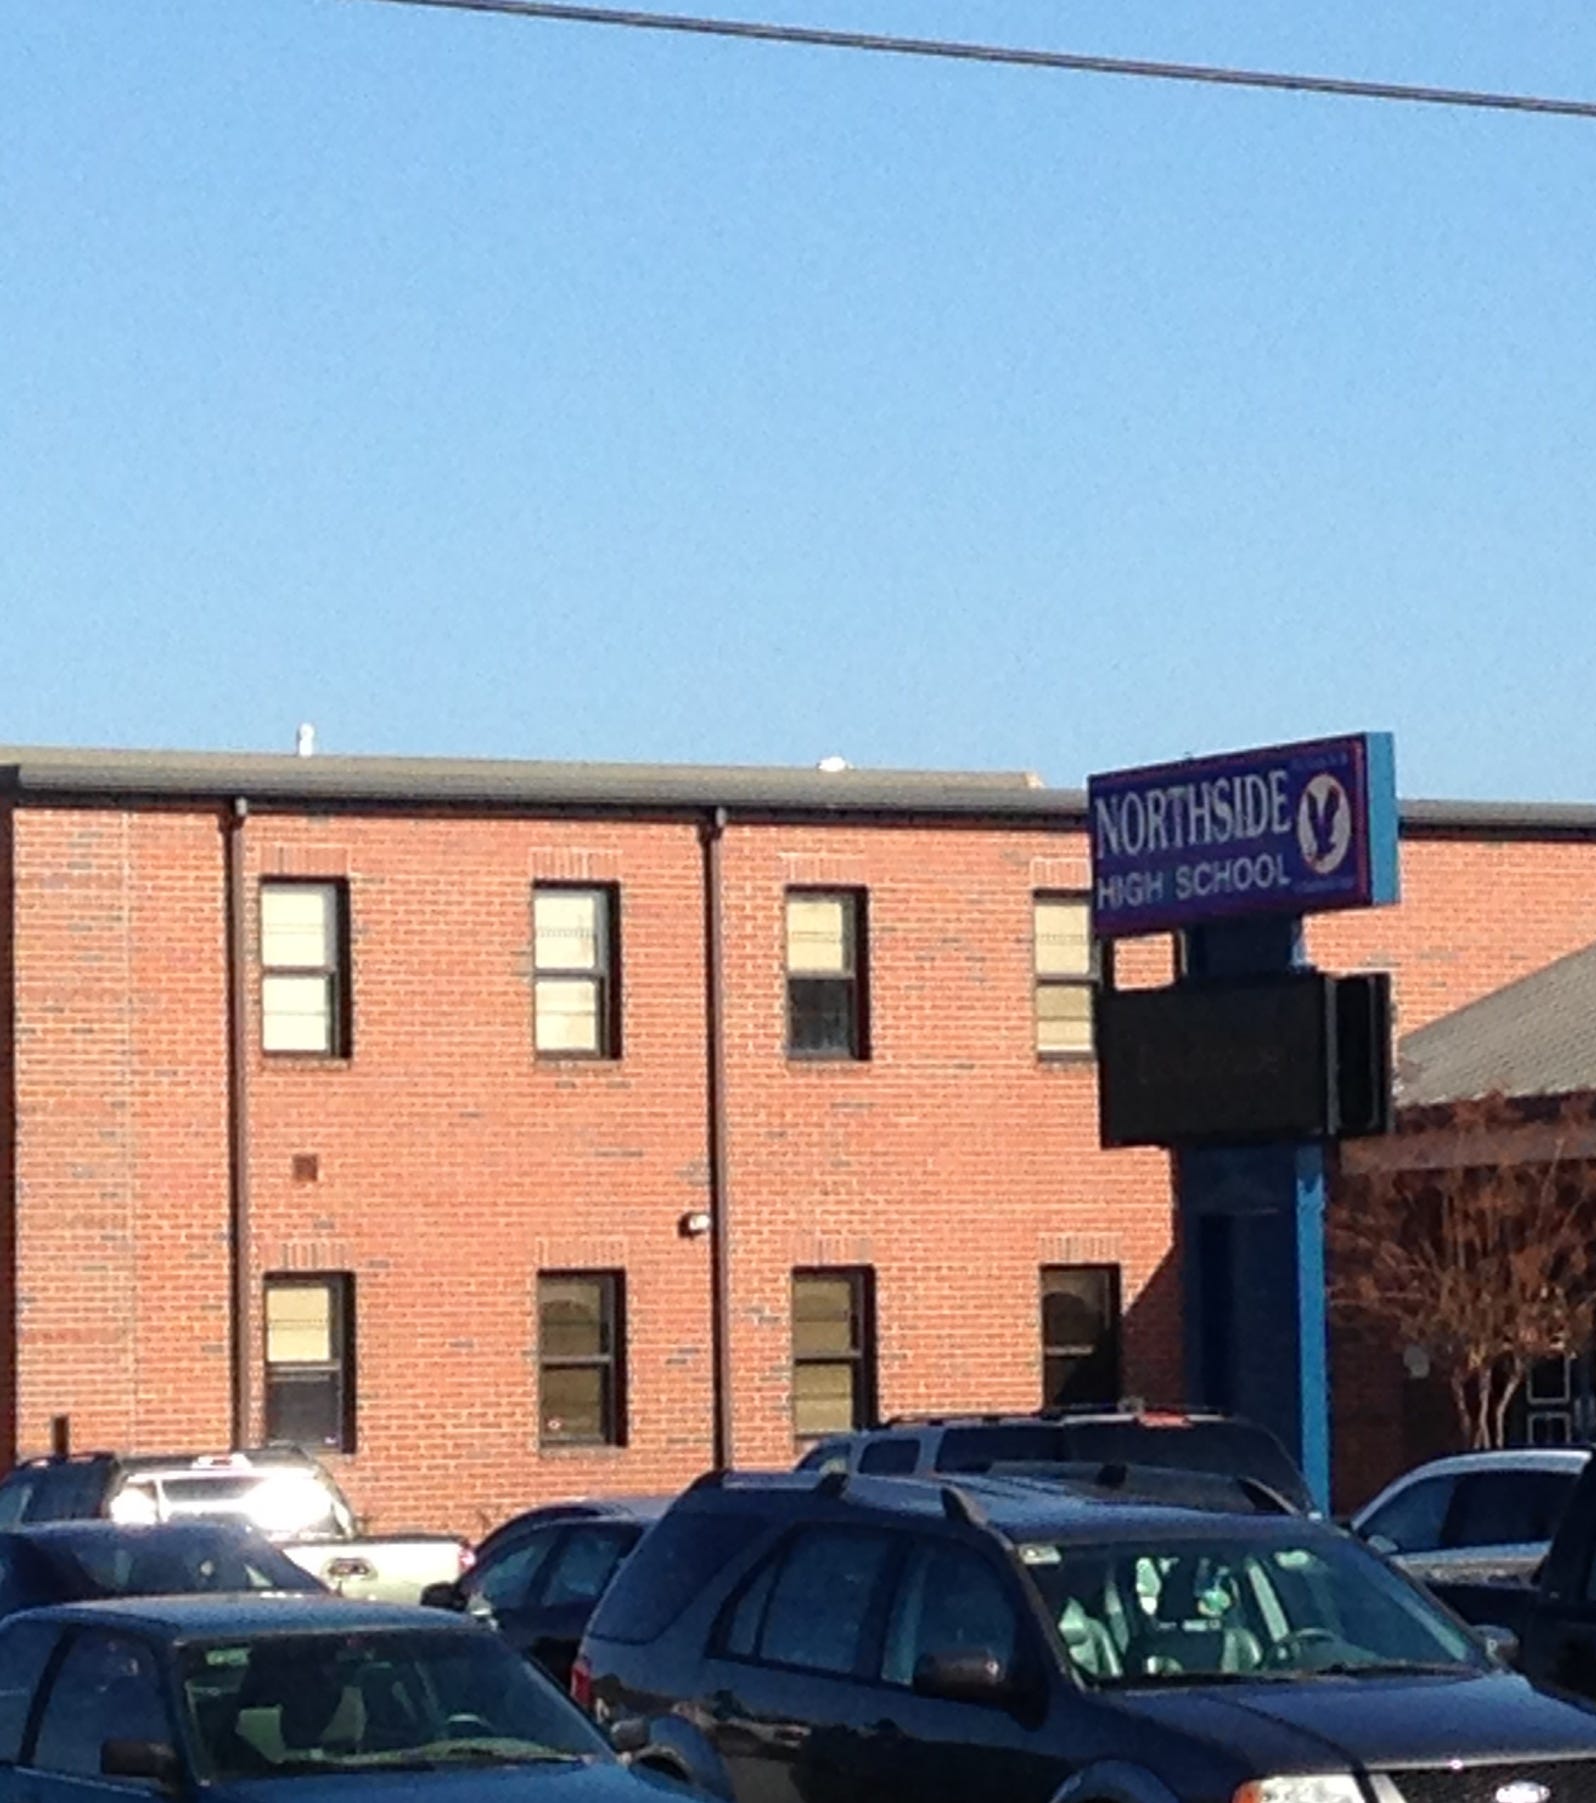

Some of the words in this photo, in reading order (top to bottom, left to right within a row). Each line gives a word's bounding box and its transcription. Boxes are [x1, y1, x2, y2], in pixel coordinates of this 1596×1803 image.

[1094, 770, 1291, 859] NORTHSIDE
[1097, 872, 1164, 910] HIGH
[1176, 853, 1291, 899] SCHOOL
